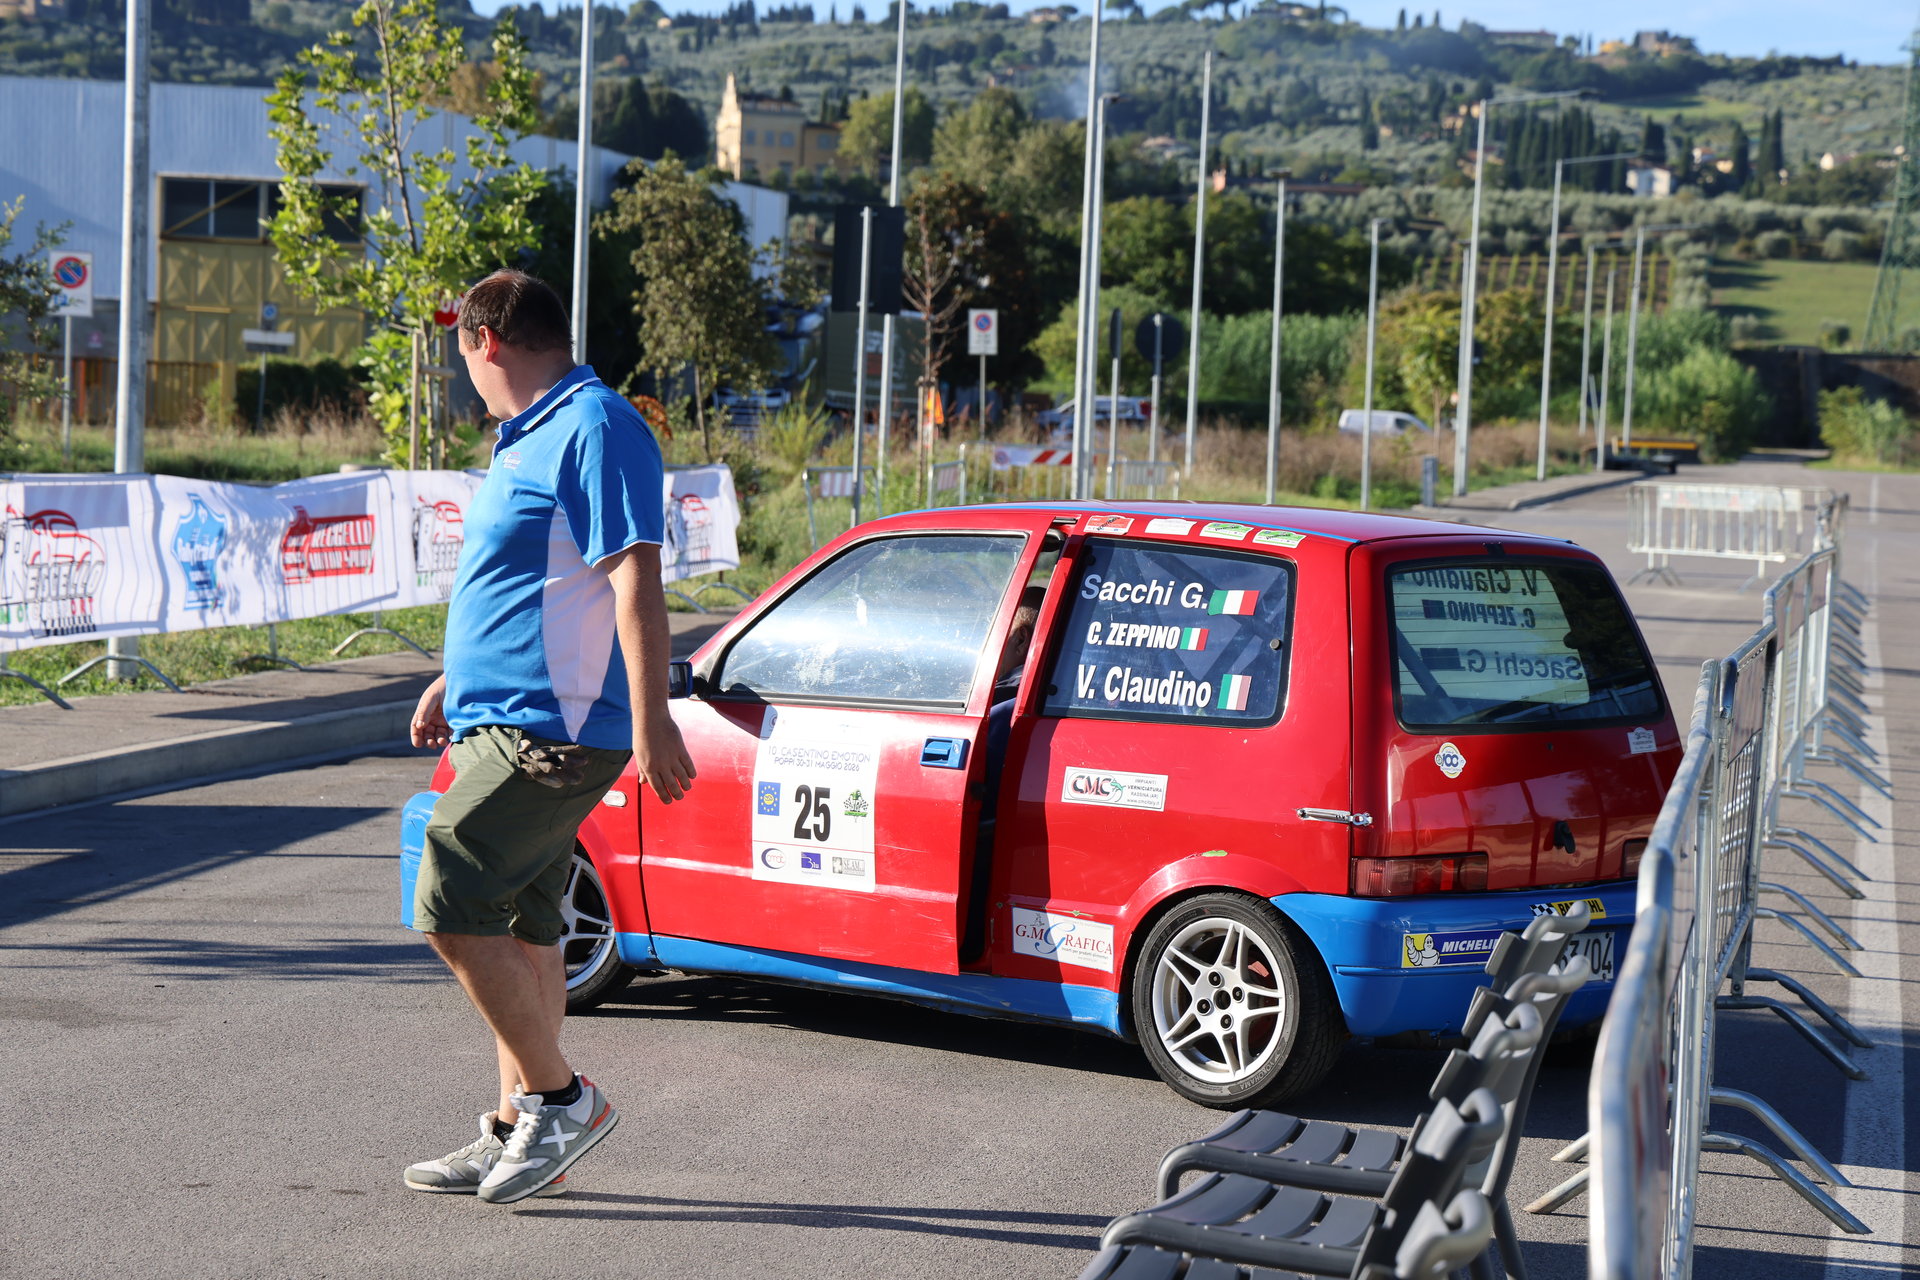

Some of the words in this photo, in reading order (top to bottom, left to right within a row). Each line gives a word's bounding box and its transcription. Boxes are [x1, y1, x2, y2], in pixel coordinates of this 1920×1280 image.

[1081, 574, 1175, 606] Sacchi
[1180, 582, 1208, 609] G.
[1087, 621, 1103, 646] C.
[1109, 622, 1181, 650] ZEPPINO
[1077, 664, 1097, 700] V.
[1104, 665, 1212, 708] Claudino
[774, 756, 794, 766] POPPI
[815, 760, 842, 770] MAGGIO
[781, 747, 829, 760] CASENTINO
[831, 750, 871, 763] EMOTION
[1071, 775, 1111, 797] CMC
[794, 784, 831, 842] 25
[1557, 899, 1603, 916] BAHL
[1559, 936, 1612, 974] 3/04
